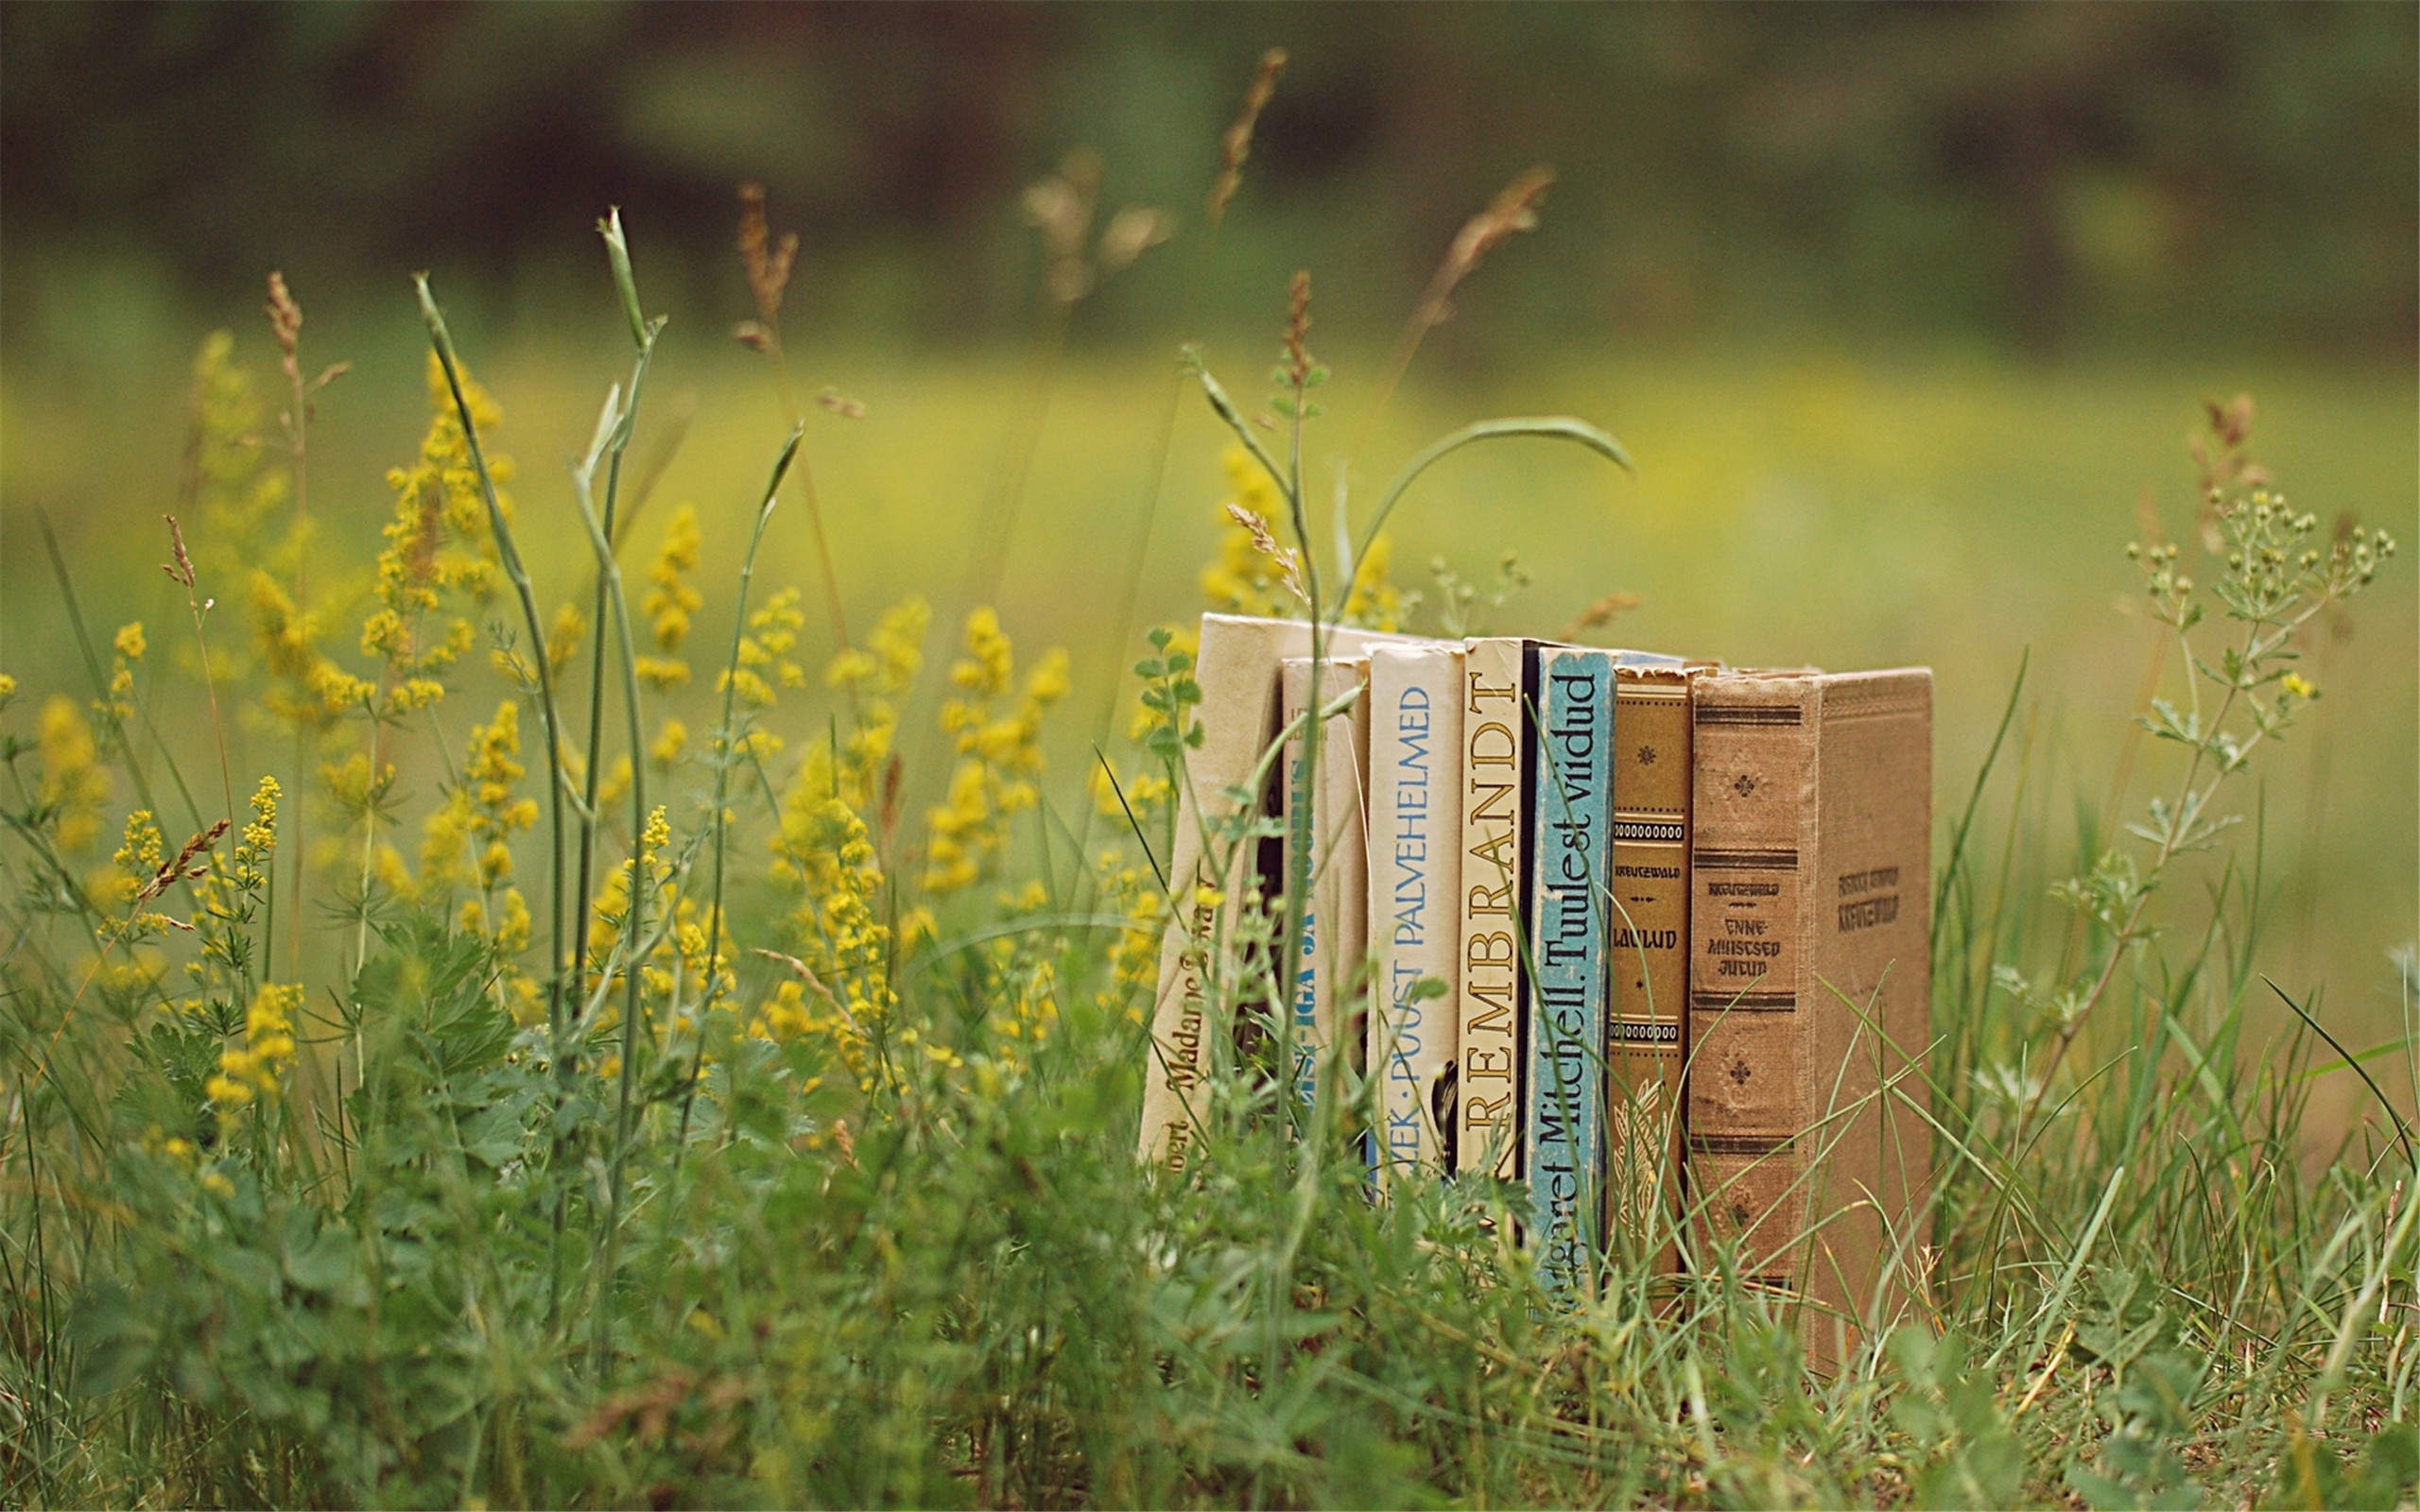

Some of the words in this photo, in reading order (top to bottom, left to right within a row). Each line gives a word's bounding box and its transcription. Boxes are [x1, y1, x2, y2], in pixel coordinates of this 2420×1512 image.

[1549, 673, 1596, 803] viidud
[1393, 686, 1430, 945] PALVEHELMED
[1544, 813, 1591, 967] Tuulest
[1466, 672, 1516, 1132] REMBRANDT
[1614, 928, 1677, 949] LAULUD
[1391, 959, 1424, 1081] PUUST
[1539, 975, 1586, 1146] Mitchell.
